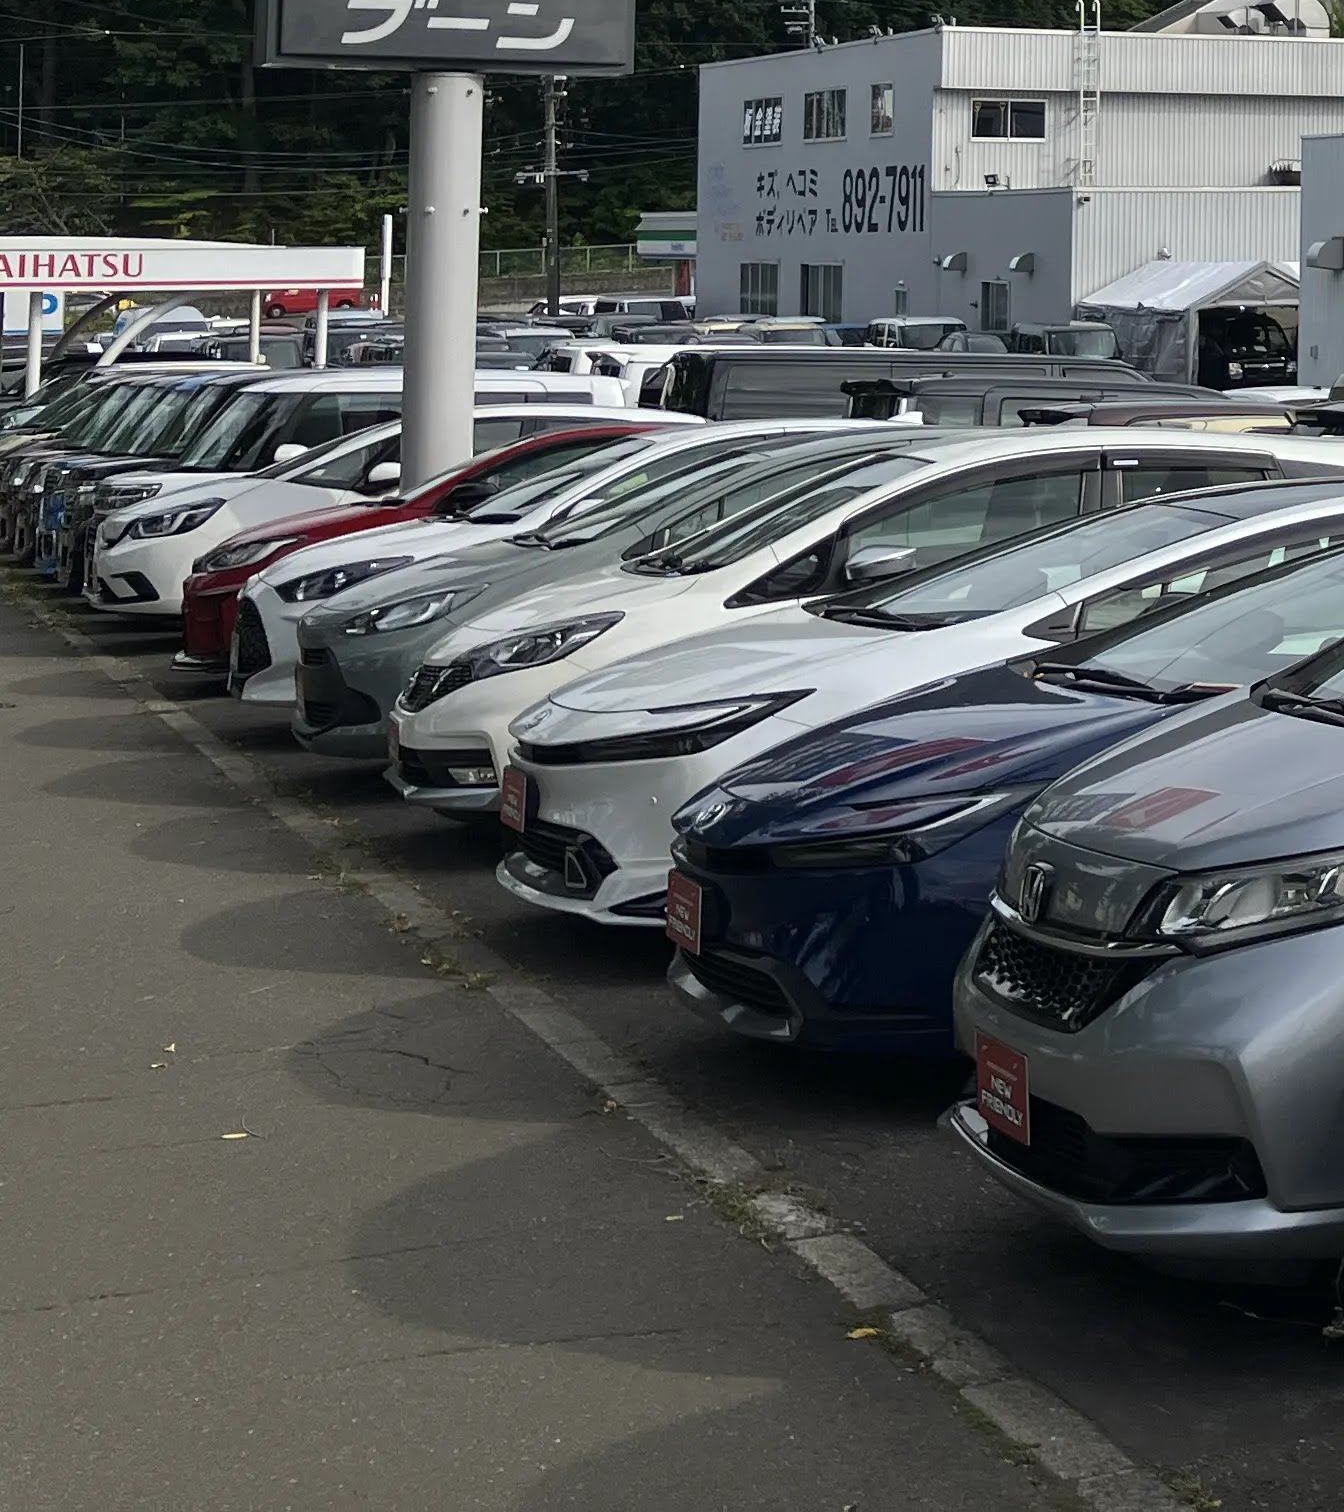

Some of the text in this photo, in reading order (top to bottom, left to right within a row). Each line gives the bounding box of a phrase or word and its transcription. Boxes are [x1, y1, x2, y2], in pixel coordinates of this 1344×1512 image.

[842, 164, 925, 234] 892-7911
[991, 1074, 1013, 1100] NEW
[981, 1088, 1023, 1128] FRIENDLY
